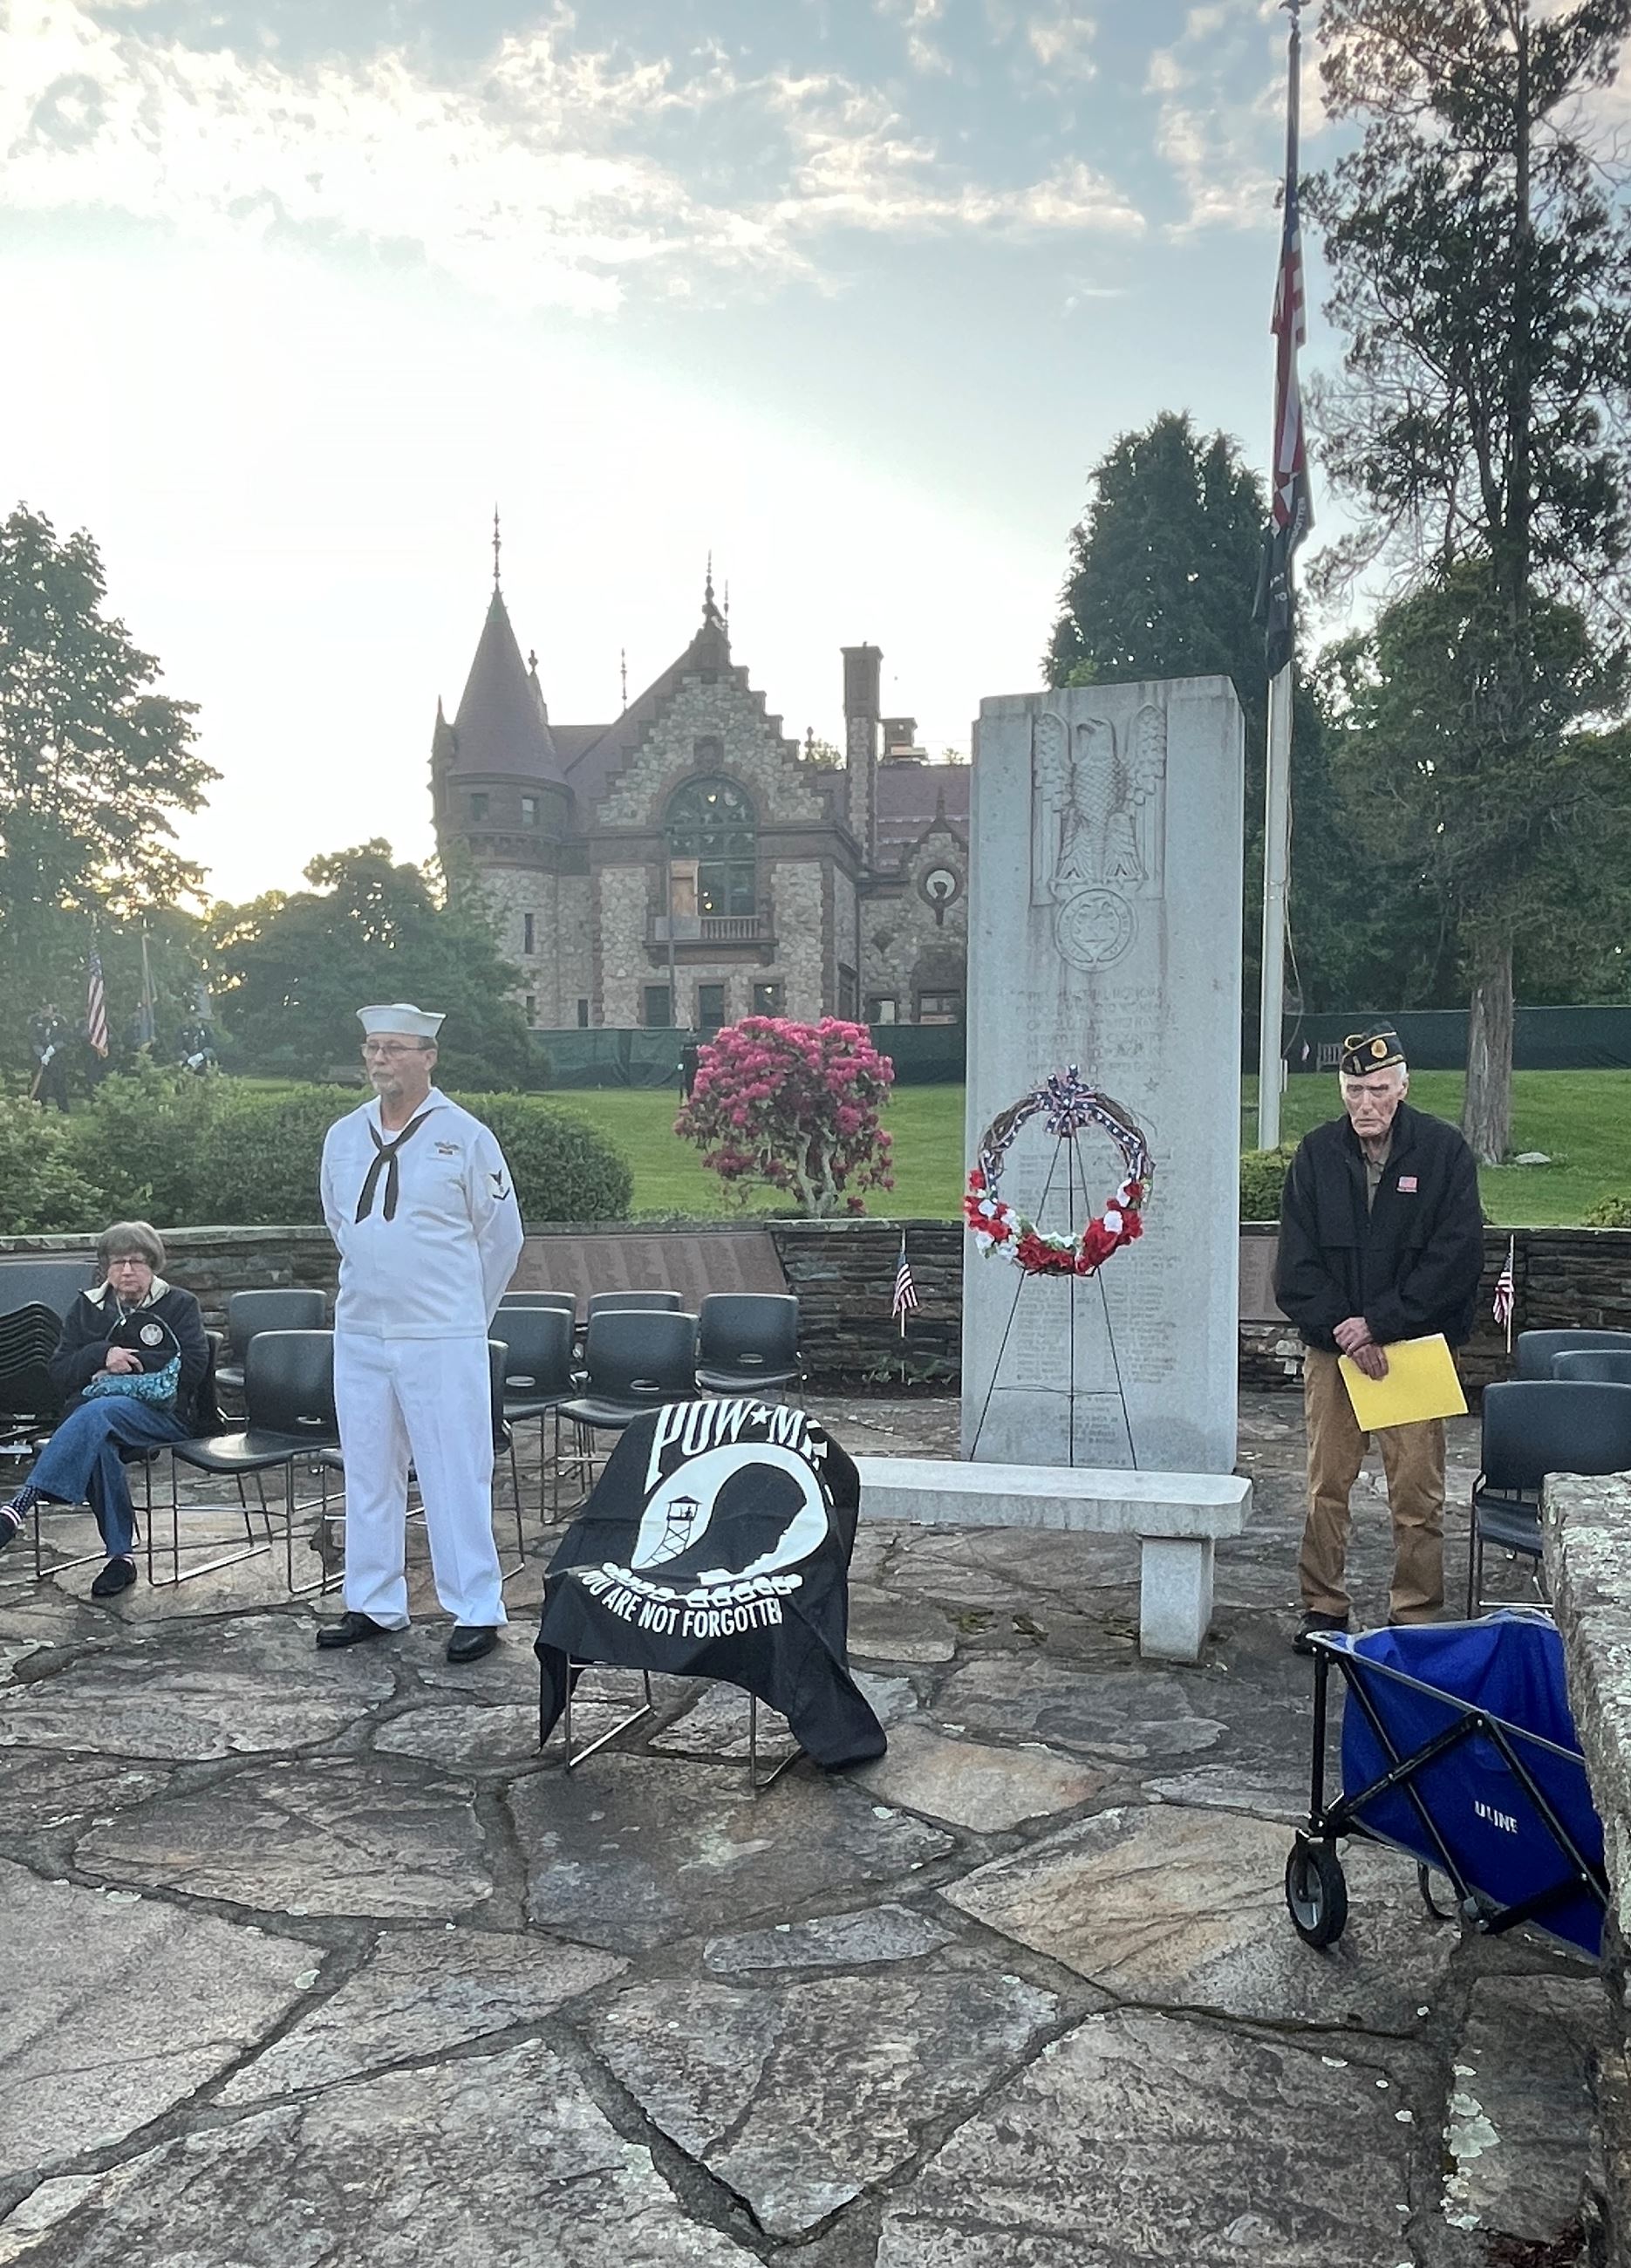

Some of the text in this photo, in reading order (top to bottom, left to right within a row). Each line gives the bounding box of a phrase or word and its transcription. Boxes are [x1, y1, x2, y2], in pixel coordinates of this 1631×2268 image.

[645, 1398, 760, 1494] POW
[578, 1570, 615, 1595] YOU
[602, 1587, 642, 1622] ARE
[638, 1601, 679, 1636] NOT
[1474, 1800, 1518, 1834] ULINE
